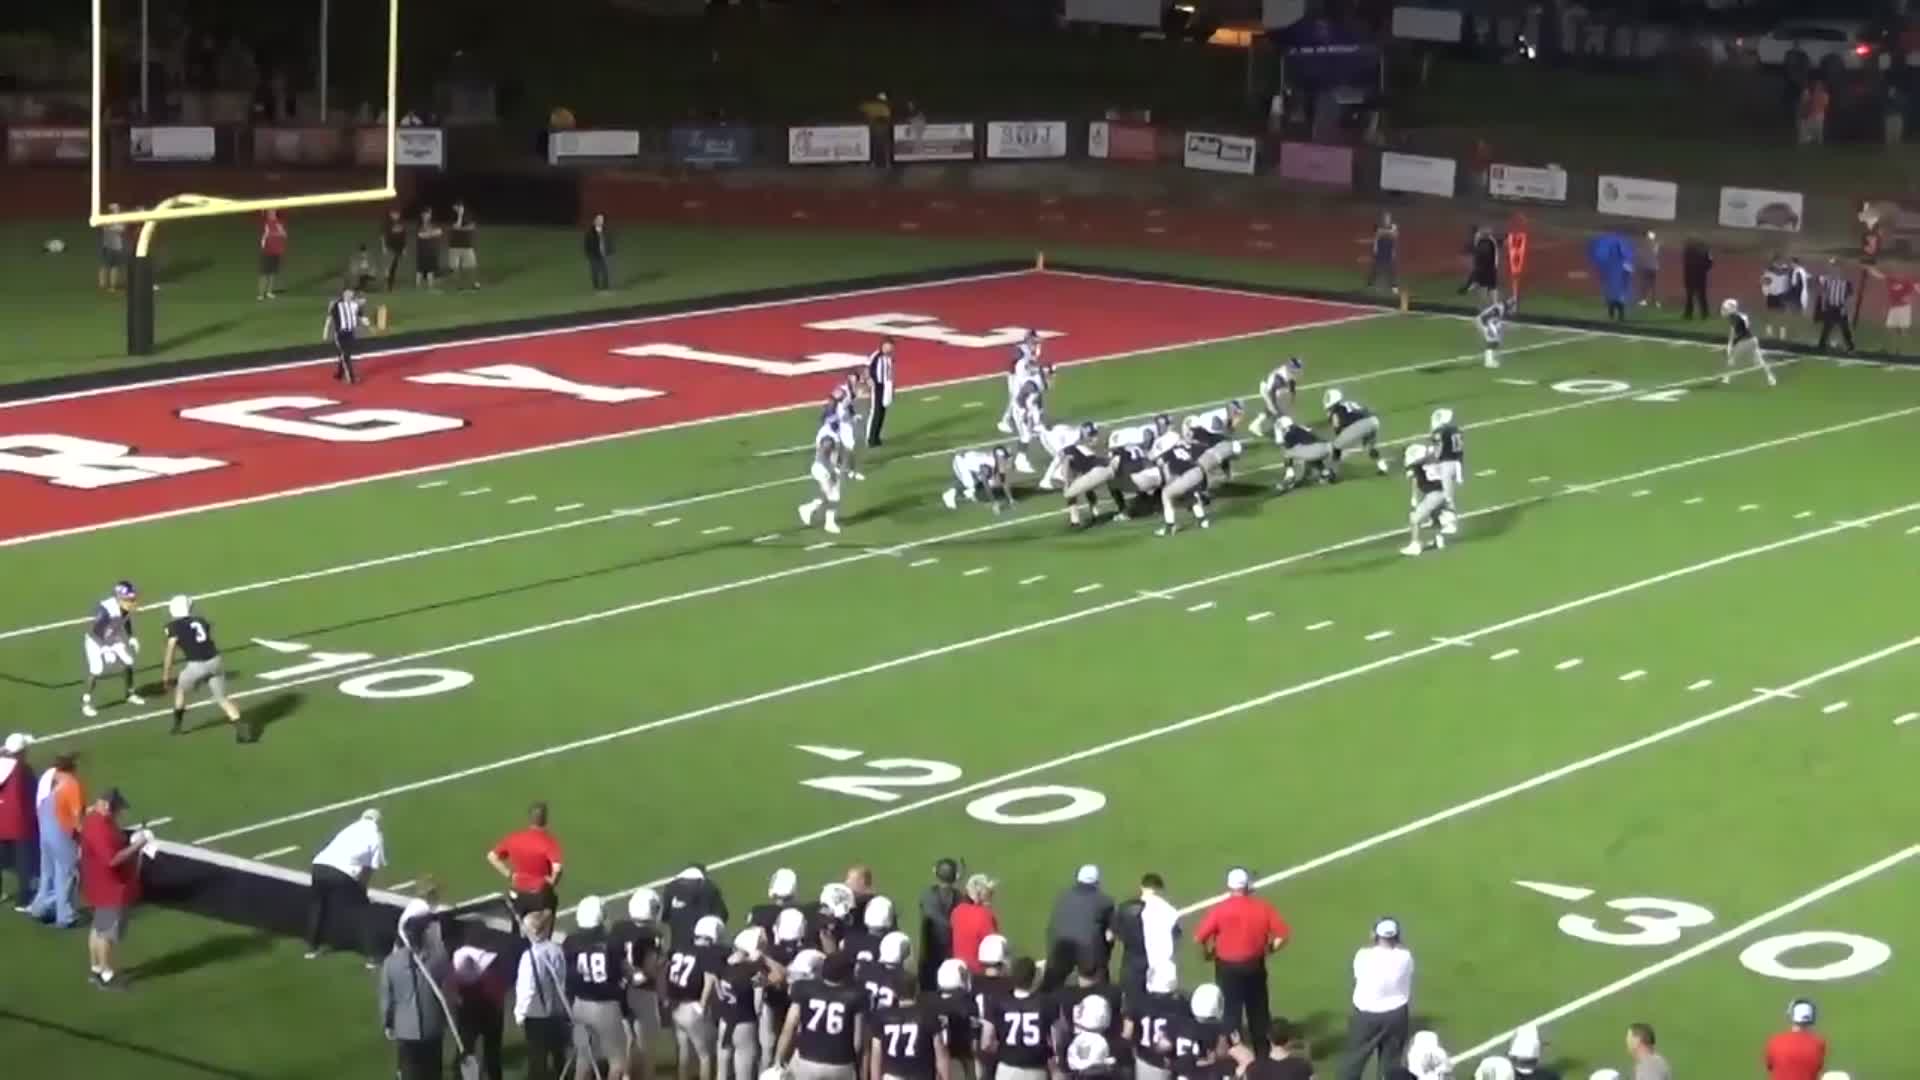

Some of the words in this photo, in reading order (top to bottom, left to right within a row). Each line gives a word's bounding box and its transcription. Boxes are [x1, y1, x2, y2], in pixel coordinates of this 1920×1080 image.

[190, 621, 207, 643] 3
[256, 651, 475, 699] 10
[798, 757, 1107, 825] 20
[1557, 896, 1892, 981] 30
[577, 952, 607, 984] 48
[669, 952, 696, 988] 27
[806, 998, 846, 1035] 76
[1004, 1012, 1040, 1046] 75
[884, 1023, 918, 1057] 77
